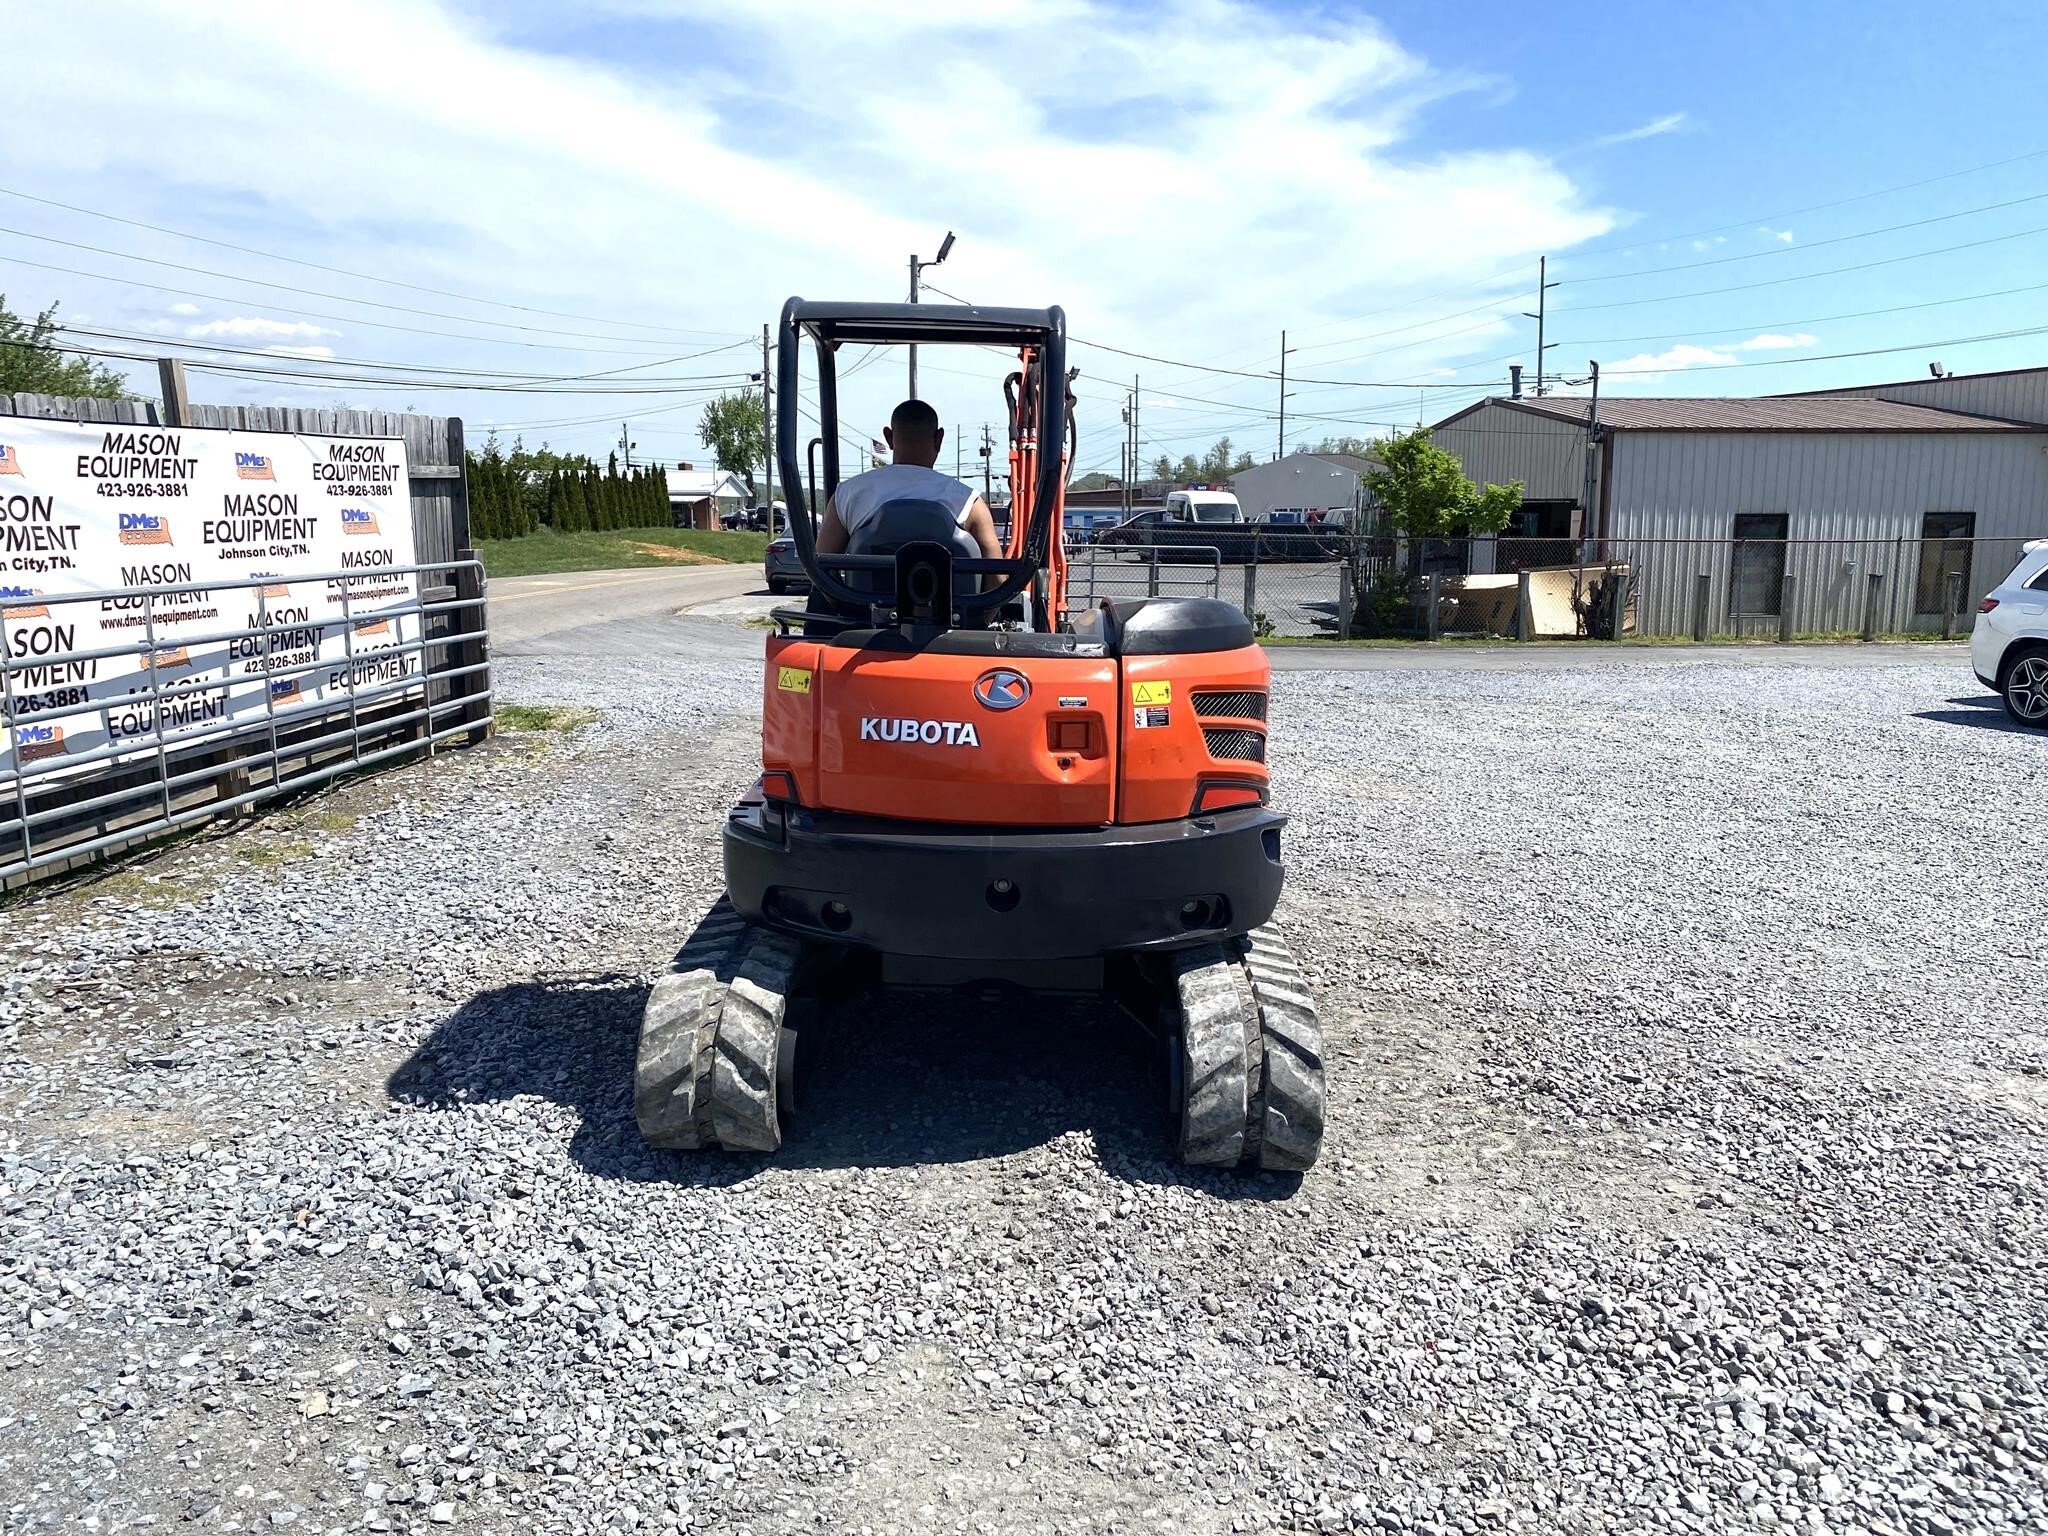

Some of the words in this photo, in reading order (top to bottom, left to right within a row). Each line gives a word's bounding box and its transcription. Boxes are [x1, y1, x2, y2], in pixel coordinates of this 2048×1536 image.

[101, 432, 180, 455] MASON
[329, 444, 384, 462] MASON
[77, 455, 198, 479] EQUIPMENT
[312, 463, 400, 481] EQUIPMENT
[96, 482, 188, 497] 423-926-3881
[326, 484, 393, 497] 423-926-3881
[224, 493, 297, 517] MASON
[203, 517, 317, 544] EQUIPMENT
[218, 548, 266, 560] Johnson
[341, 548, 392, 568] MASON
[121, 562, 191, 587] MASON
[860, 717, 980, 748] KUBOTA
